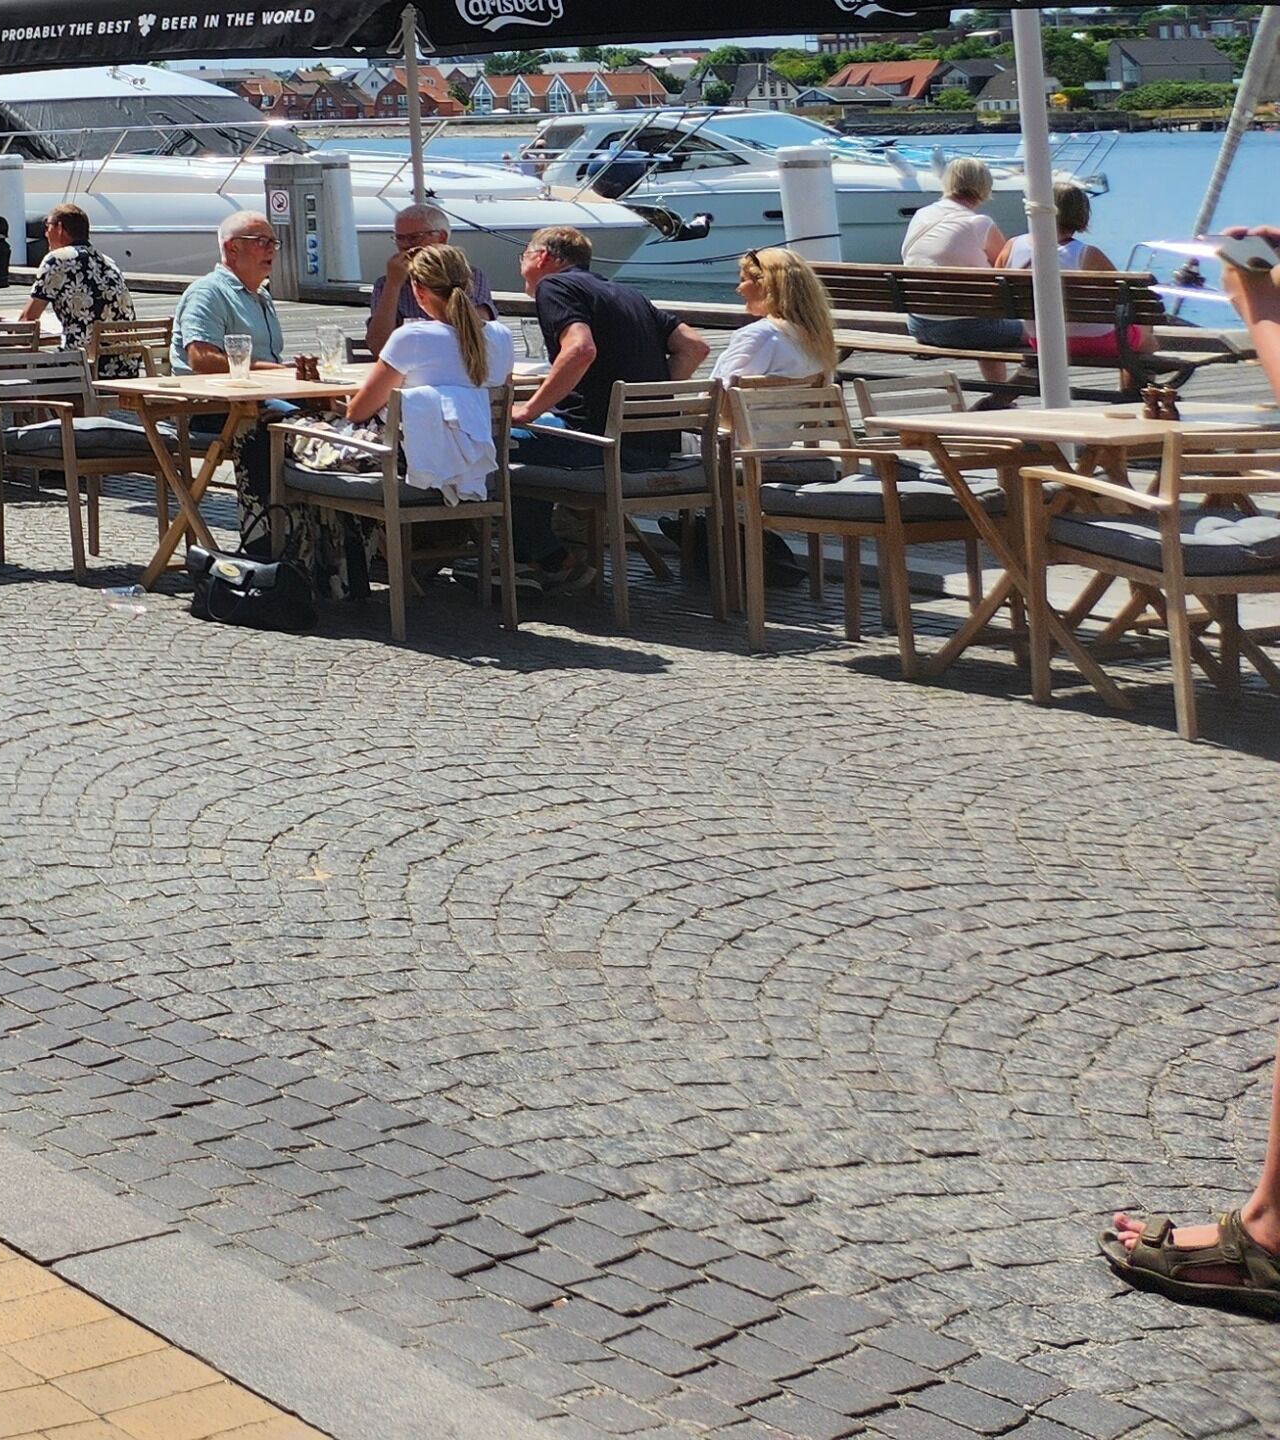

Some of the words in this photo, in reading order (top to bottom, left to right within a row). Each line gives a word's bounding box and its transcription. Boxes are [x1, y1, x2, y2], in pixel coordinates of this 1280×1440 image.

[1, 24, 66, 42] PROBABLY
[68, 22, 94, 36] THE
[97, 19, 132, 35] BEST
[161, 15, 200, 31] BEER
[203, 14, 220, 29] IN
[226, 12, 256, 27] THE
[262, 9, 316, 25] WORLD
